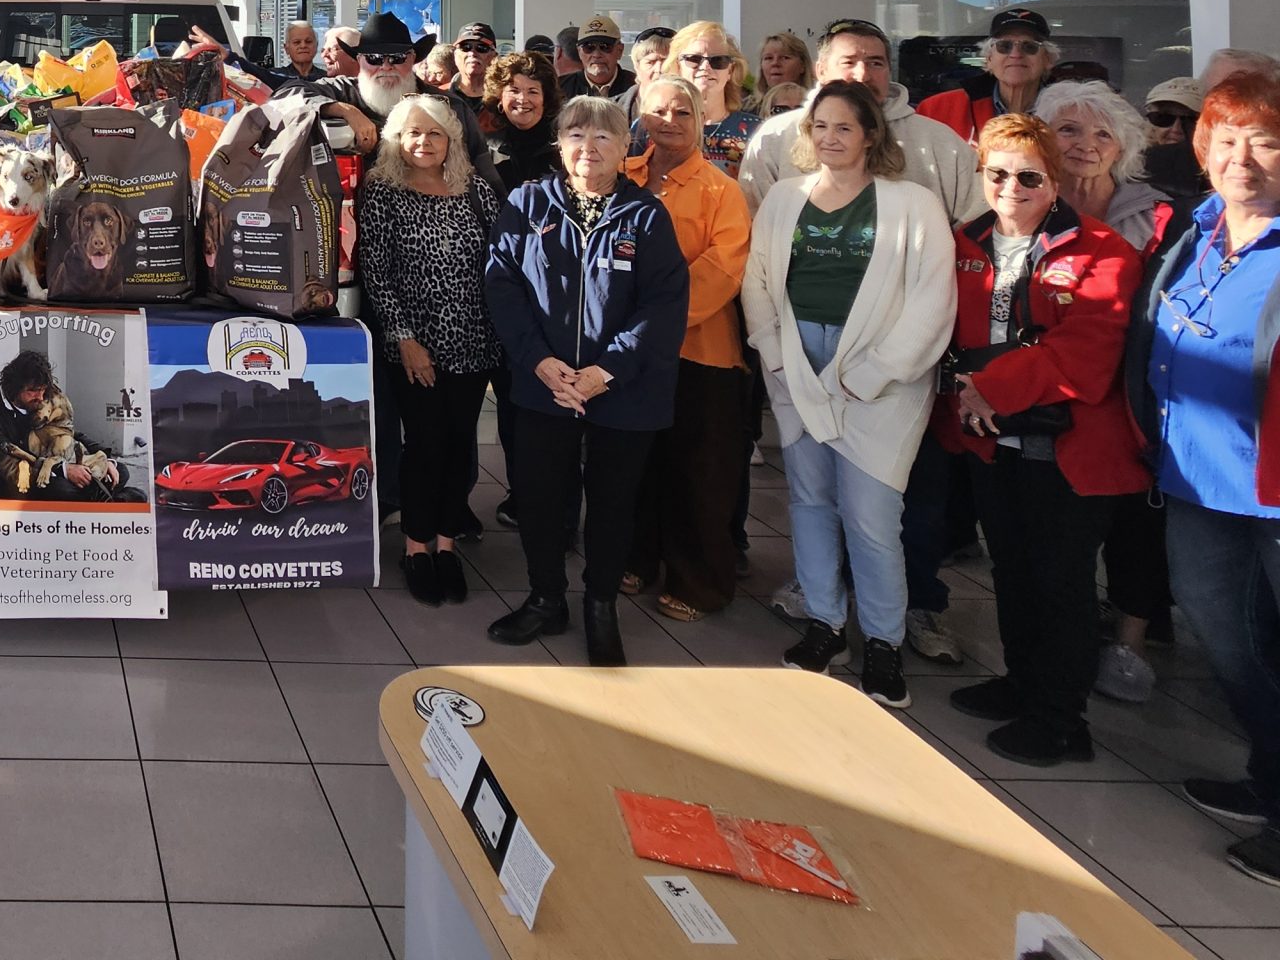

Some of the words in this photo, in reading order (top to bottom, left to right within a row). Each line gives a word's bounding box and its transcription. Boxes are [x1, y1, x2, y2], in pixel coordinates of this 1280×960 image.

[93, 127, 135, 135] KIRKLAND
[91, 173, 120, 185] WEIGHT
[120, 177, 140, 187] DOG
[140, 171, 179, 184] FORMULA
[315, 217, 323, 246] WEIGHT
[242, 327, 269, 339] RENO
[106, 406, 142, 418] PETS
[15, 520, 43, 534] Pets
[47, 520, 60, 534] of
[65, 520, 87, 535] the
[91, 521, 153, 535] Homeles
[251, 522, 285, 539] our
[288, 517, 348, 538] dream
[55, 549, 79, 561] Pet
[83, 549, 118, 562] Food
[122, 549, 135, 562] &
[0, 566, 78, 581] Veterinary
[81, 567, 115, 579] Care
[189, 562, 236, 579] RENO
[239, 561, 344, 579] CORVETTES
[212, 581, 291, 590] ESTABLISHED
[293, 580, 321, 589] 1972
